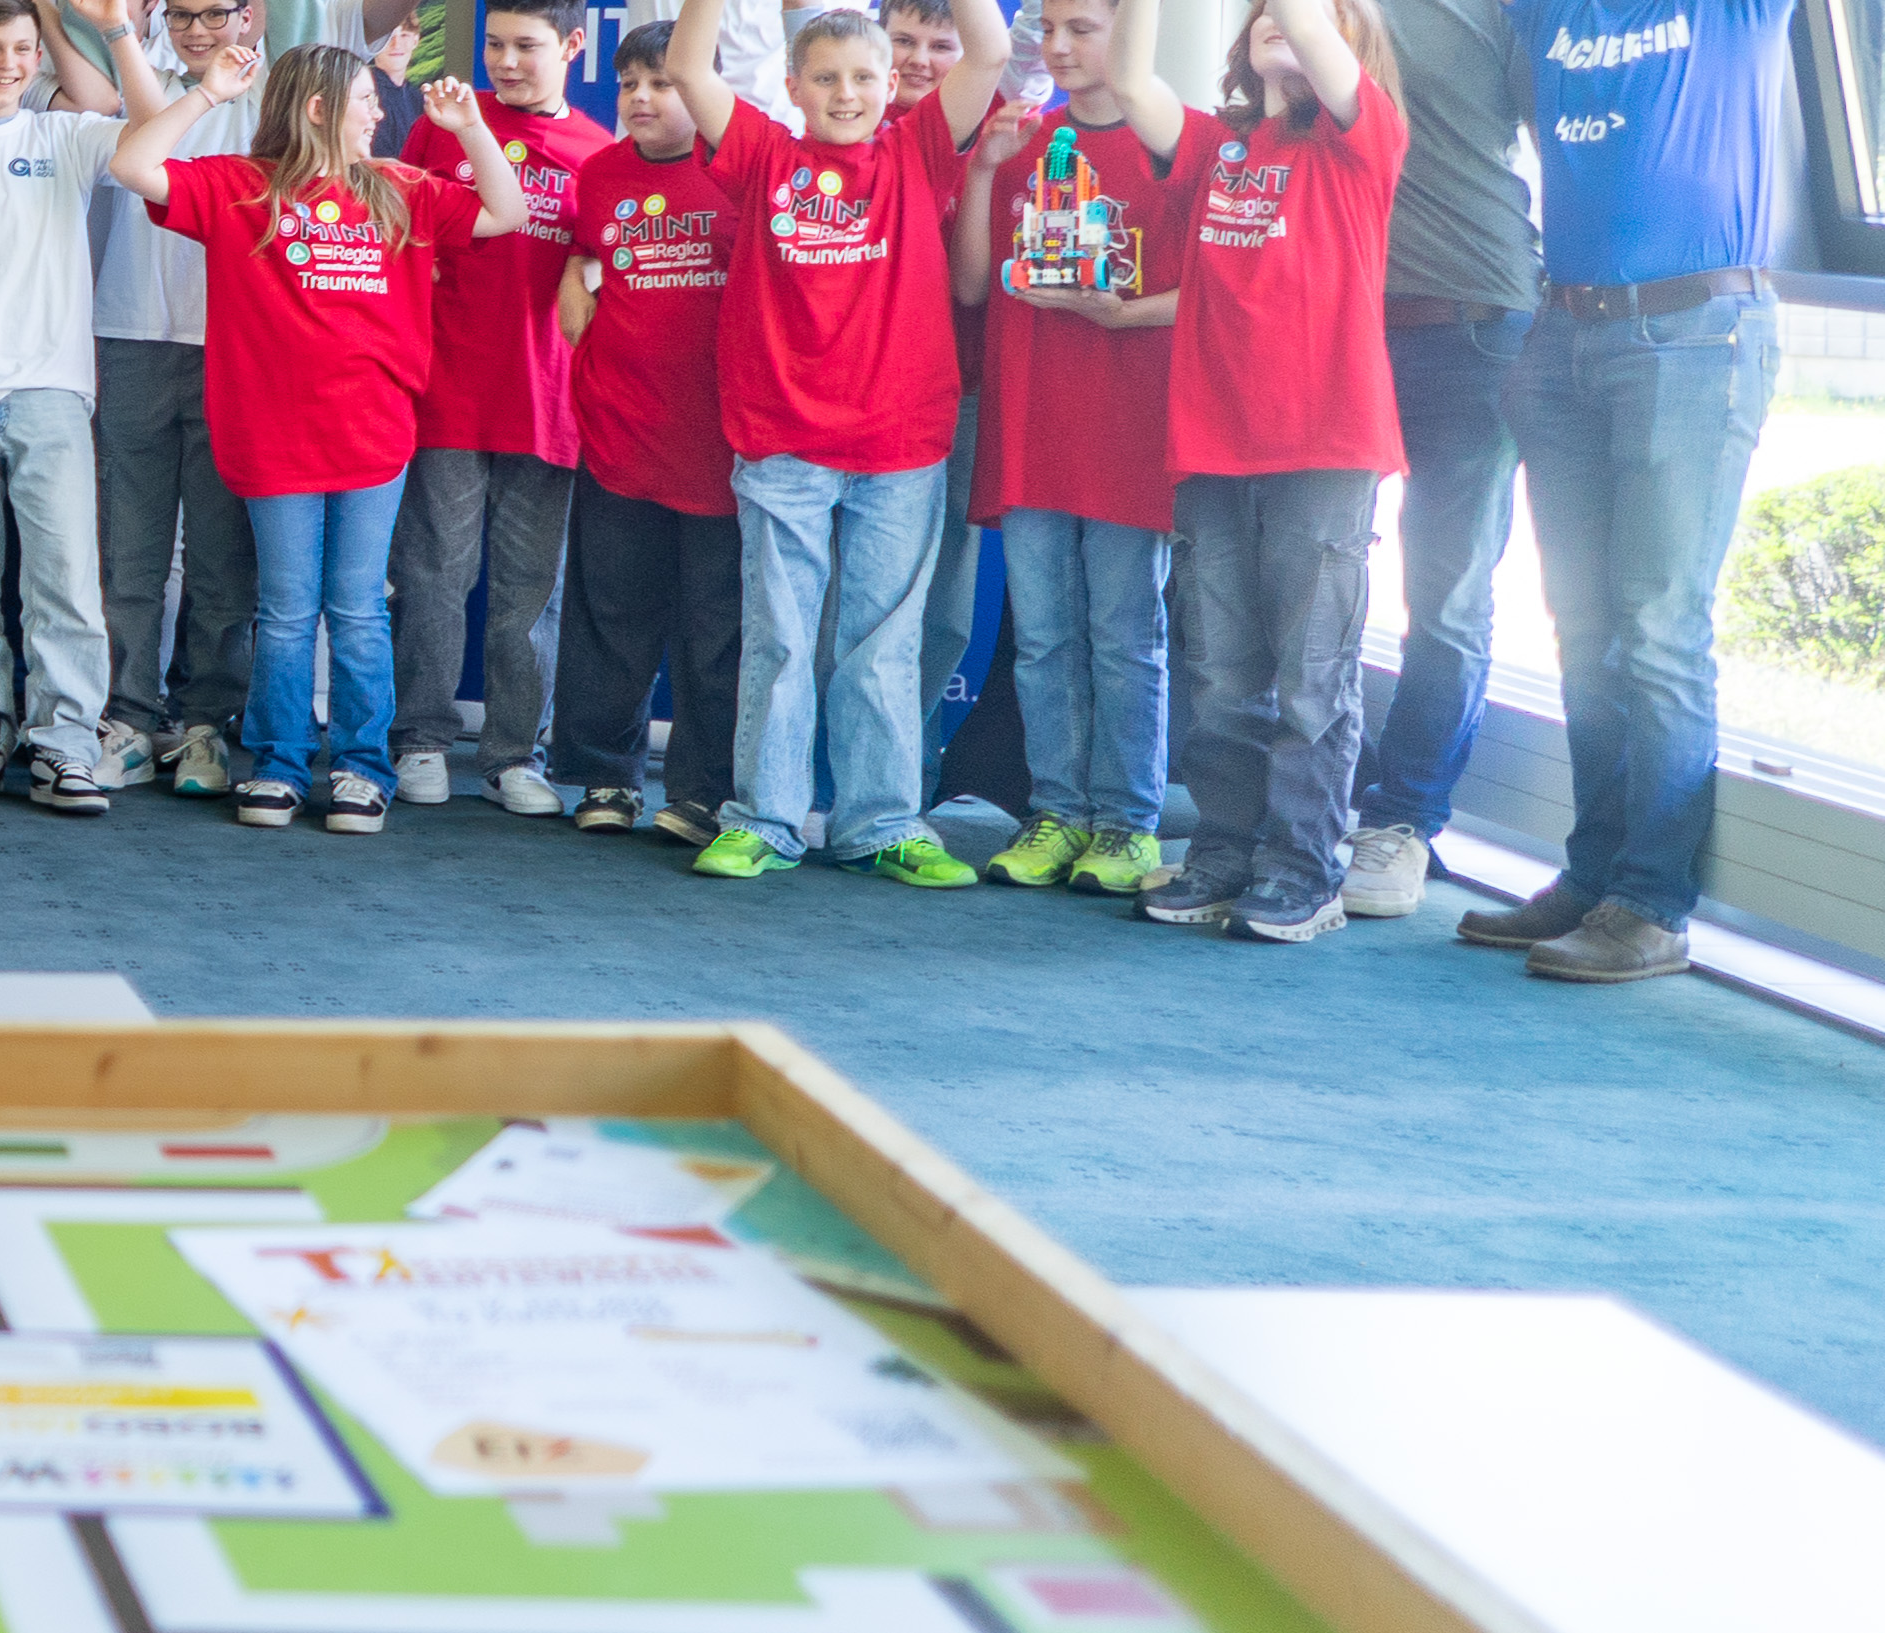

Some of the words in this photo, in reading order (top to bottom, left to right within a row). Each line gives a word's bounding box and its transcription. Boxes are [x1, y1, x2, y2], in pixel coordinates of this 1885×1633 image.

[620, 211, 718, 245] MINT
[655, 240, 712, 260] Region
[777, 237, 888, 265] Traunviertel
[624, 269, 729, 291] Traunvierte
